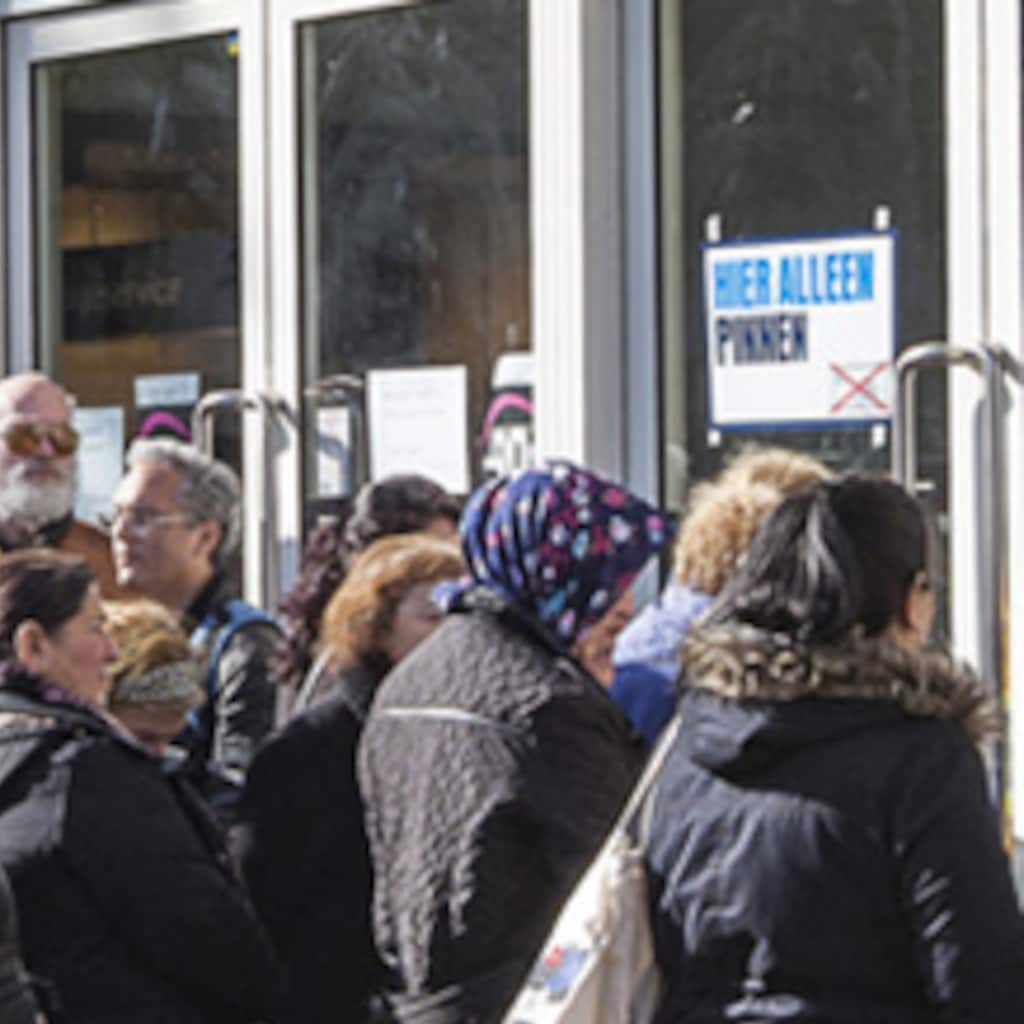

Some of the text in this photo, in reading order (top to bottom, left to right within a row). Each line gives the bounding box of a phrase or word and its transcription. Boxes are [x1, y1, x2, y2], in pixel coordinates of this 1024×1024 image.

[714, 250, 874, 309] HIER ALLEEN
[715, 311, 808, 366] PINNEN
